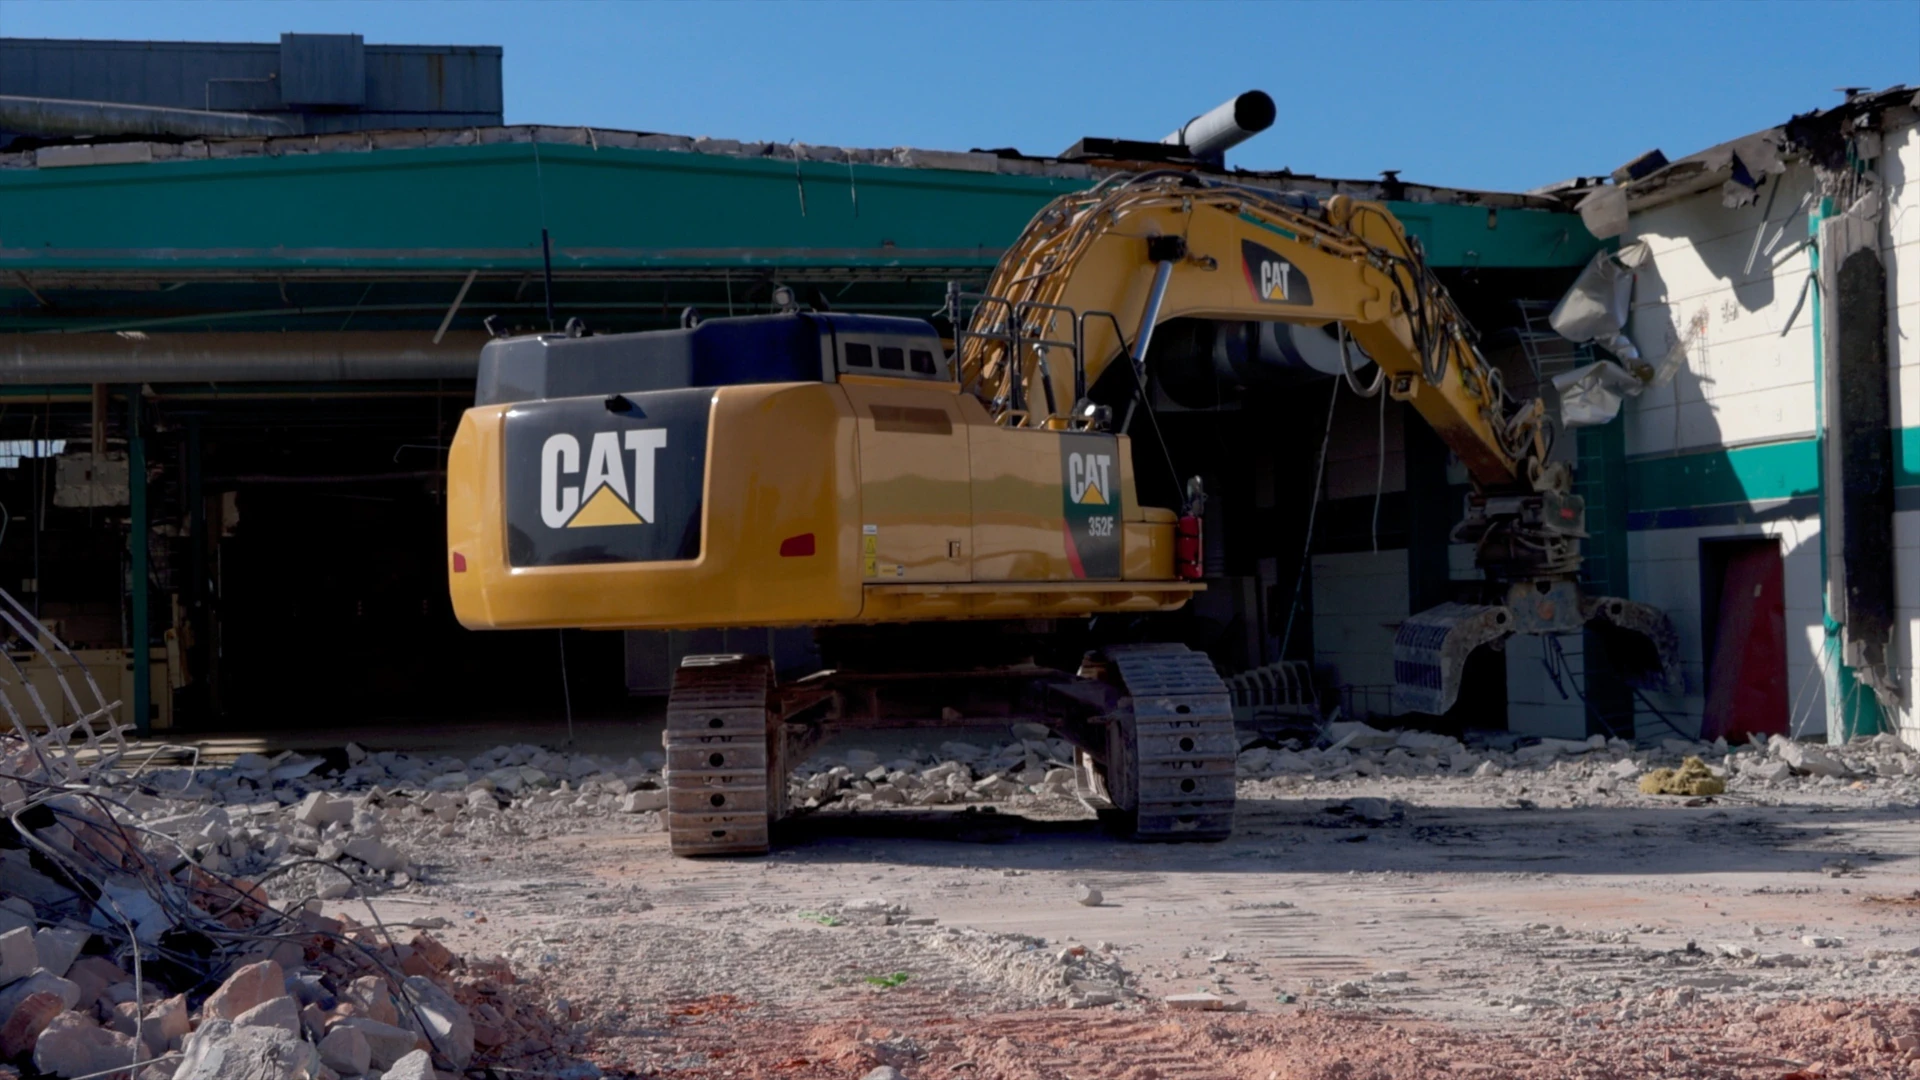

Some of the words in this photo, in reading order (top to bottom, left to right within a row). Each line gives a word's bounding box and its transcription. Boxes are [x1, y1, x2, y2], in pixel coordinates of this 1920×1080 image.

[1261, 260, 1290, 300] CAT
[541, 428, 667, 528] CAT
[1069, 452, 1111, 505] CAT
[1088, 516, 1113, 536] 352F
